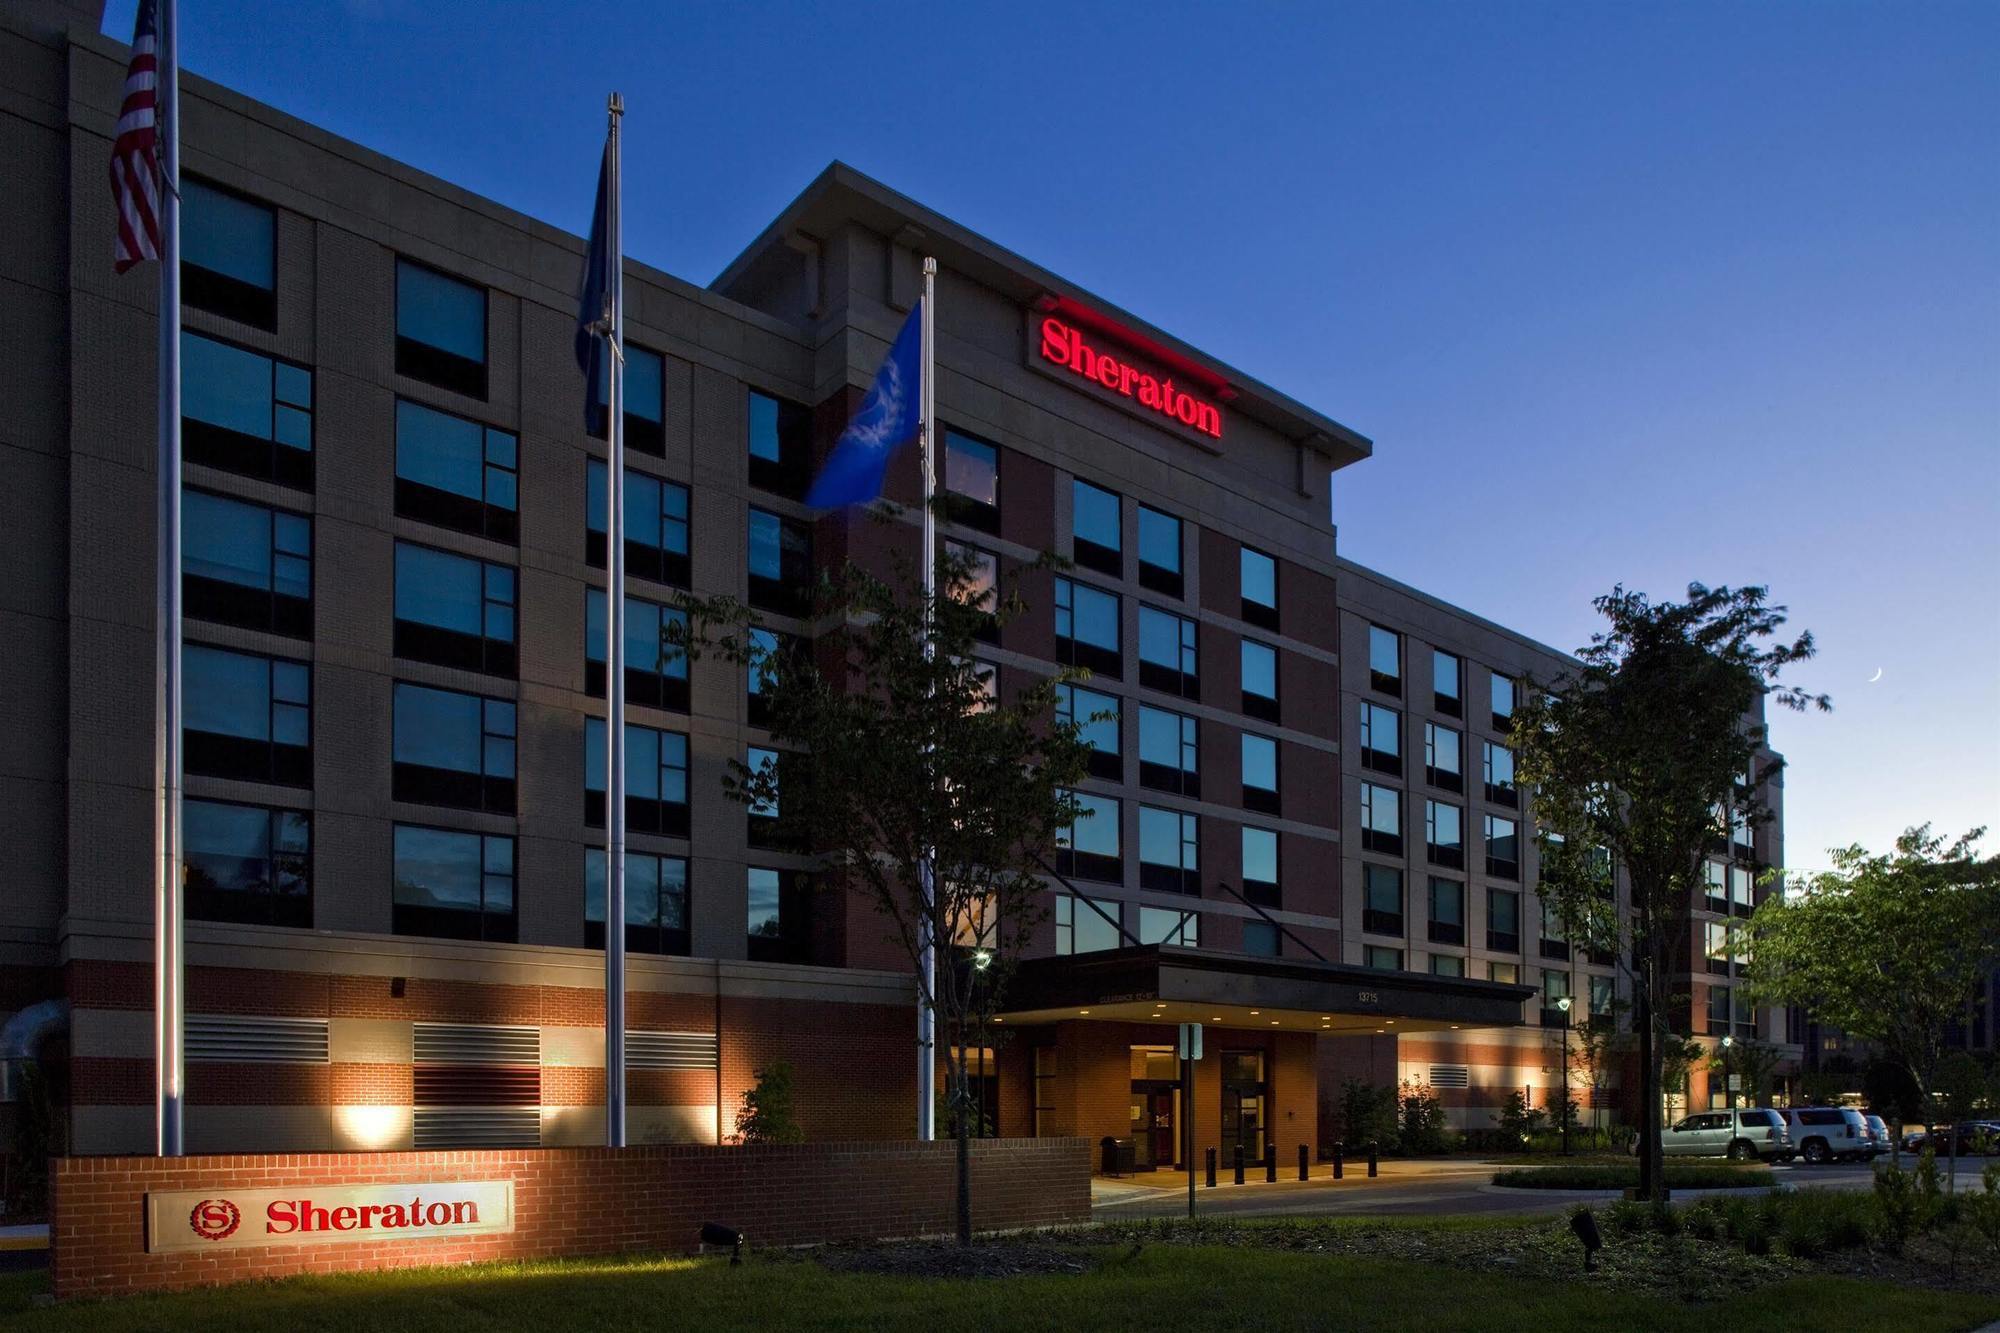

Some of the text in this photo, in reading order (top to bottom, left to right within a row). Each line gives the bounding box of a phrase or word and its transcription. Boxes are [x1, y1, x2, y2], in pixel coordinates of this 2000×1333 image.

[1041, 318, 1221, 437] Sheraton
[201, 1205, 230, 1229] S
[266, 1197, 480, 1234] Sheraton
